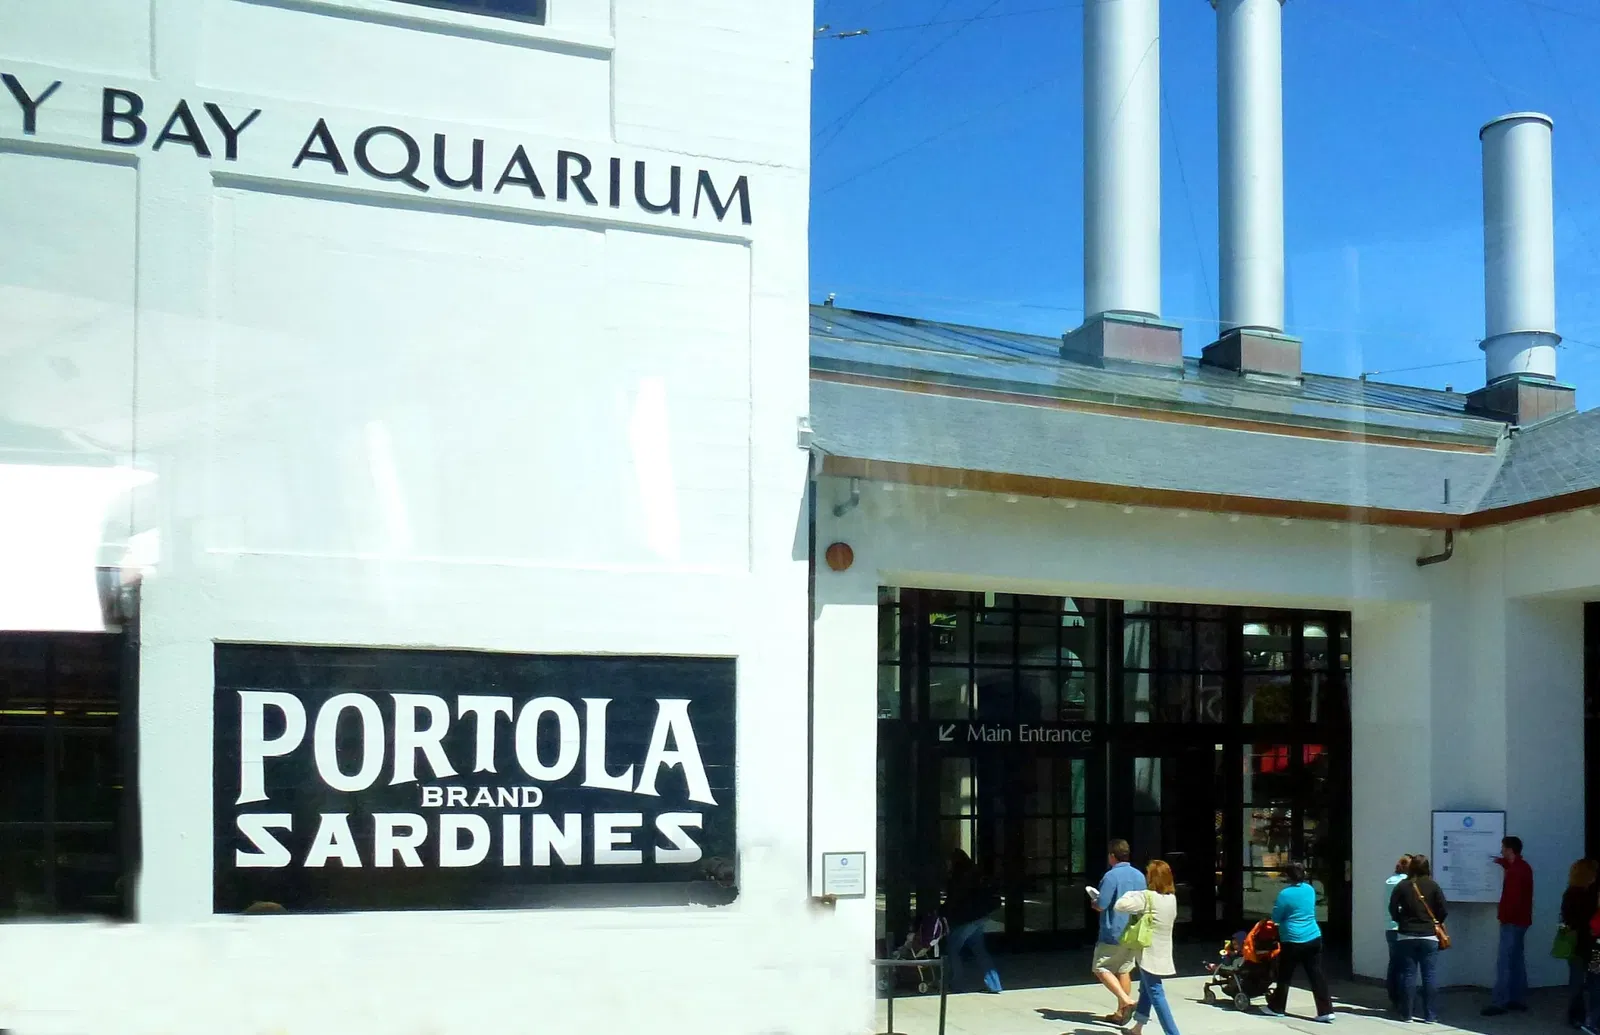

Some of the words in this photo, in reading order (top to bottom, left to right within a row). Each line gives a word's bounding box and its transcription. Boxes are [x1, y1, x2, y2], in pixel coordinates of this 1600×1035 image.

[101, 87, 262, 161] BAY
[292, 117, 752, 224] AQUARIUM
[235, 690, 719, 806] PORTOLA
[967, 724, 1012, 742] Main
[1019, 724, 1092, 742] Entrance
[420, 785, 544, 808] BRAND
[235, 812, 704, 868] SARDINES
